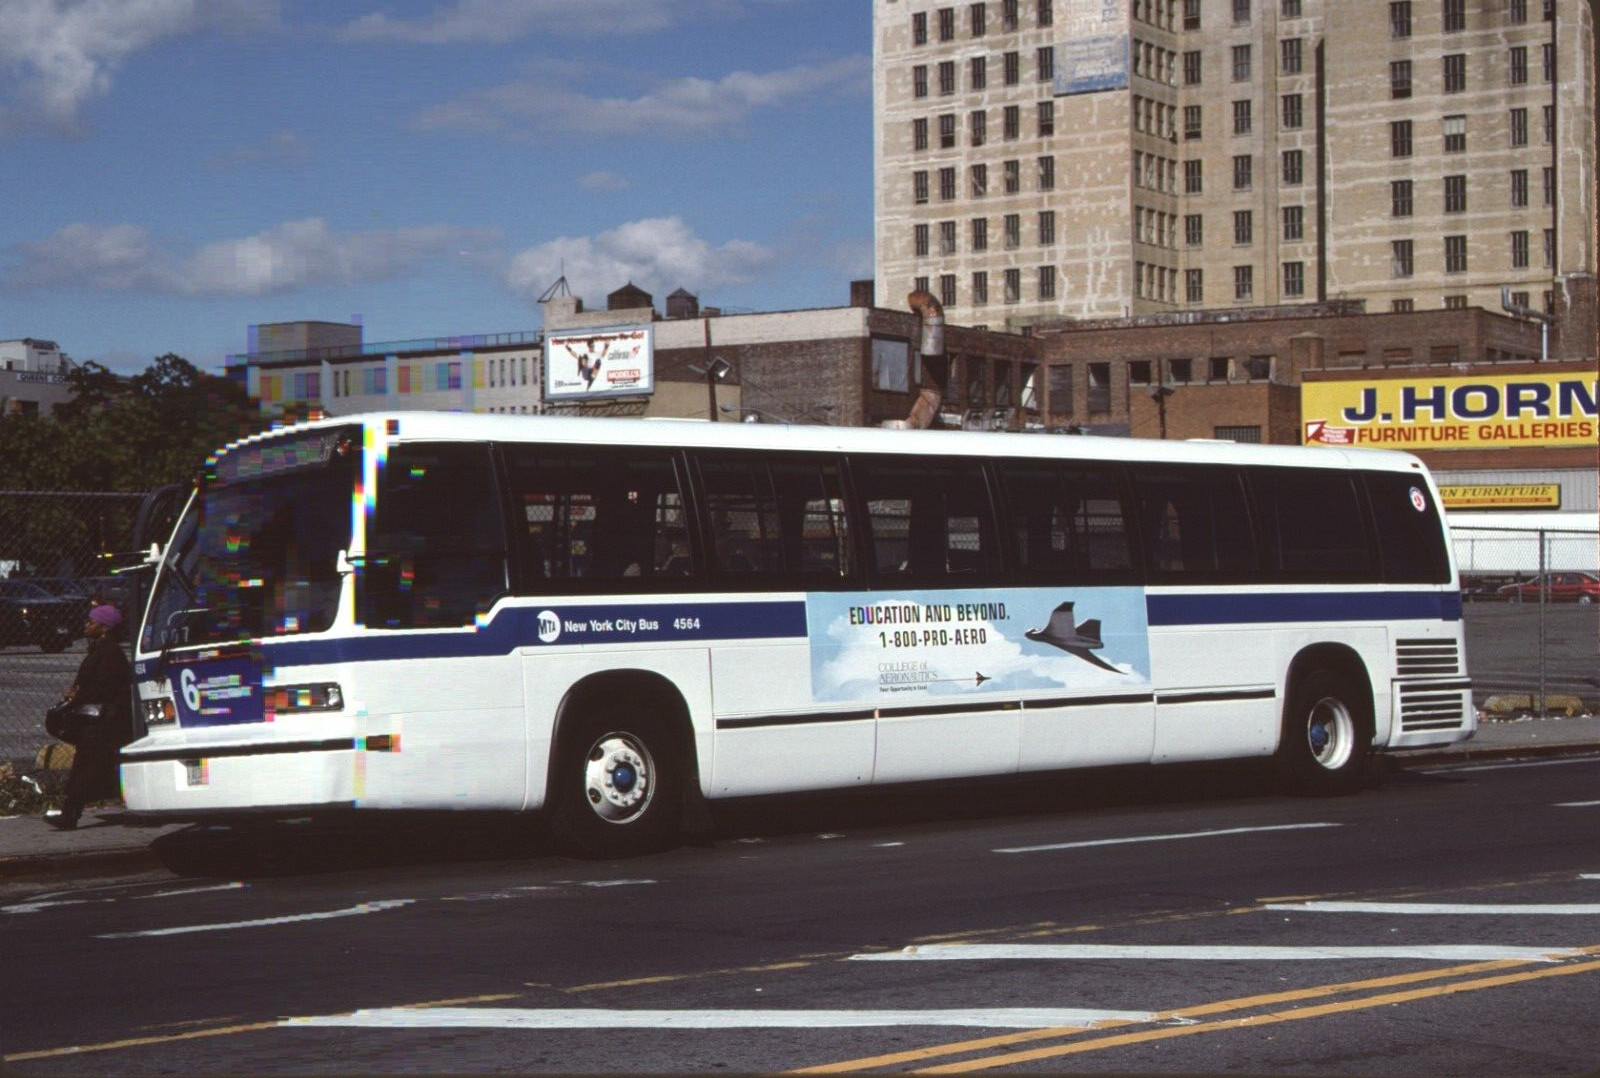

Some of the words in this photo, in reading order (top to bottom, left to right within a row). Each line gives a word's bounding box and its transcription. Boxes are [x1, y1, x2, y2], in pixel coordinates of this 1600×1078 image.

[1357, 426, 1469, 443] FURNITURE
[1478, 422, 1592, 440] GALLERIES
[1462, 486, 1551, 497] FURNITURE
[849, 605, 921, 625] EDUCATION
[925, 604, 952, 624] AND
[956, 602, 1011, 622] BEYOND.
[564, 620, 587, 633] New
[589, 619, 613, 632] York
[615, 618, 636, 634] City
[639, 618, 659, 631] Bus
[673, 617, 701, 630] 4564
[878, 627, 987, 648] 1-800-PRO-AERO
[878, 661, 918, 672] COLLEGE
[879, 671, 938, 683] AERONAUTICS
[180, 667, 201, 711] 6
